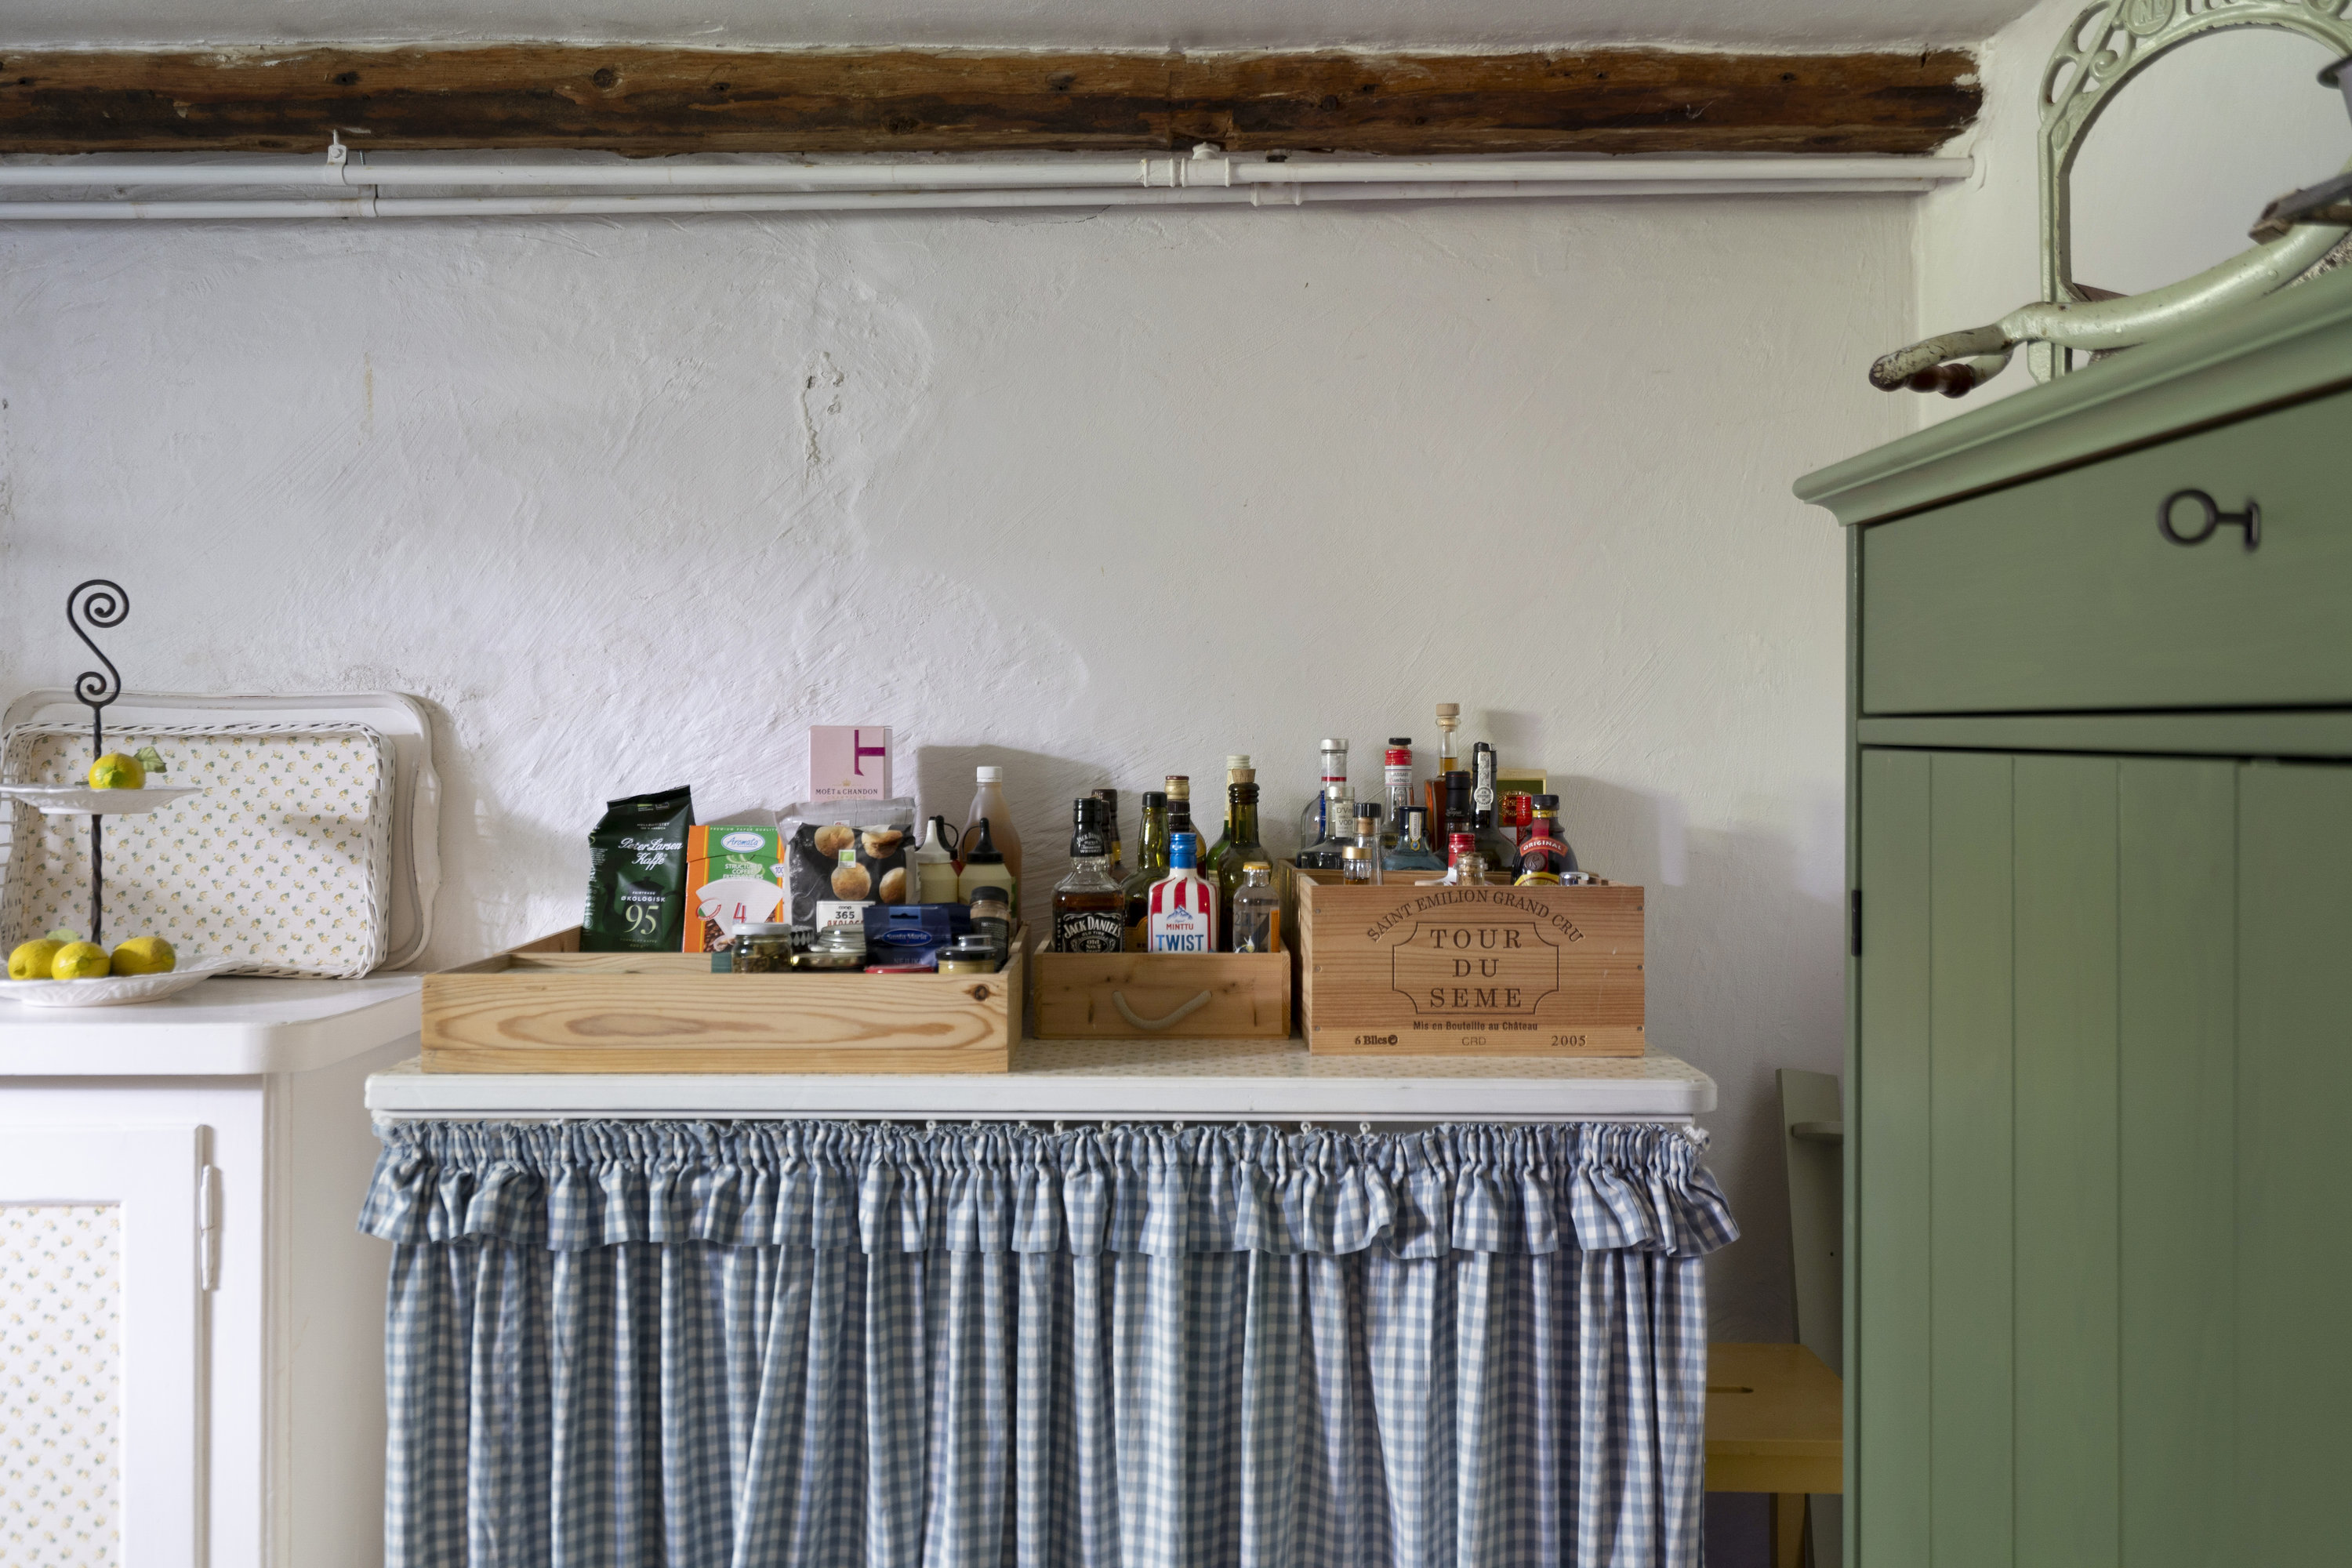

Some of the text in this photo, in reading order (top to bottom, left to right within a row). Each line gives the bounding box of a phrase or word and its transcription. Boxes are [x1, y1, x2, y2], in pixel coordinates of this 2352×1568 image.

[618, 837, 683, 851] Peter Larsen
[726, 837, 758, 846] Aromata
[1523, 840, 1562, 851] ORIGINAL
[623, 905, 659, 935] 95
[733, 902, 746, 924] 4
[835, 911, 855, 920] 365
[1367, 890, 1584, 942] SAINT EMILION GRAND CRU
[1064, 920, 1086, 938] JACK
[1087, 916, 1121, 938] DANIEL'S
[1156, 935, 1204, 952] TWIST
[1430, 929, 1522, 949] TOUR
[1453, 959, 1500, 978] DU
[1430, 989, 1522, 1008] SEME
[1414, 1021, 1538, 1031] Mis en Bouteille au Château
[1355, 1036, 1361, 1045] 6
[1461, 1036, 1486, 1046] CRD
[1551, 1035, 1587, 1047] 2005
